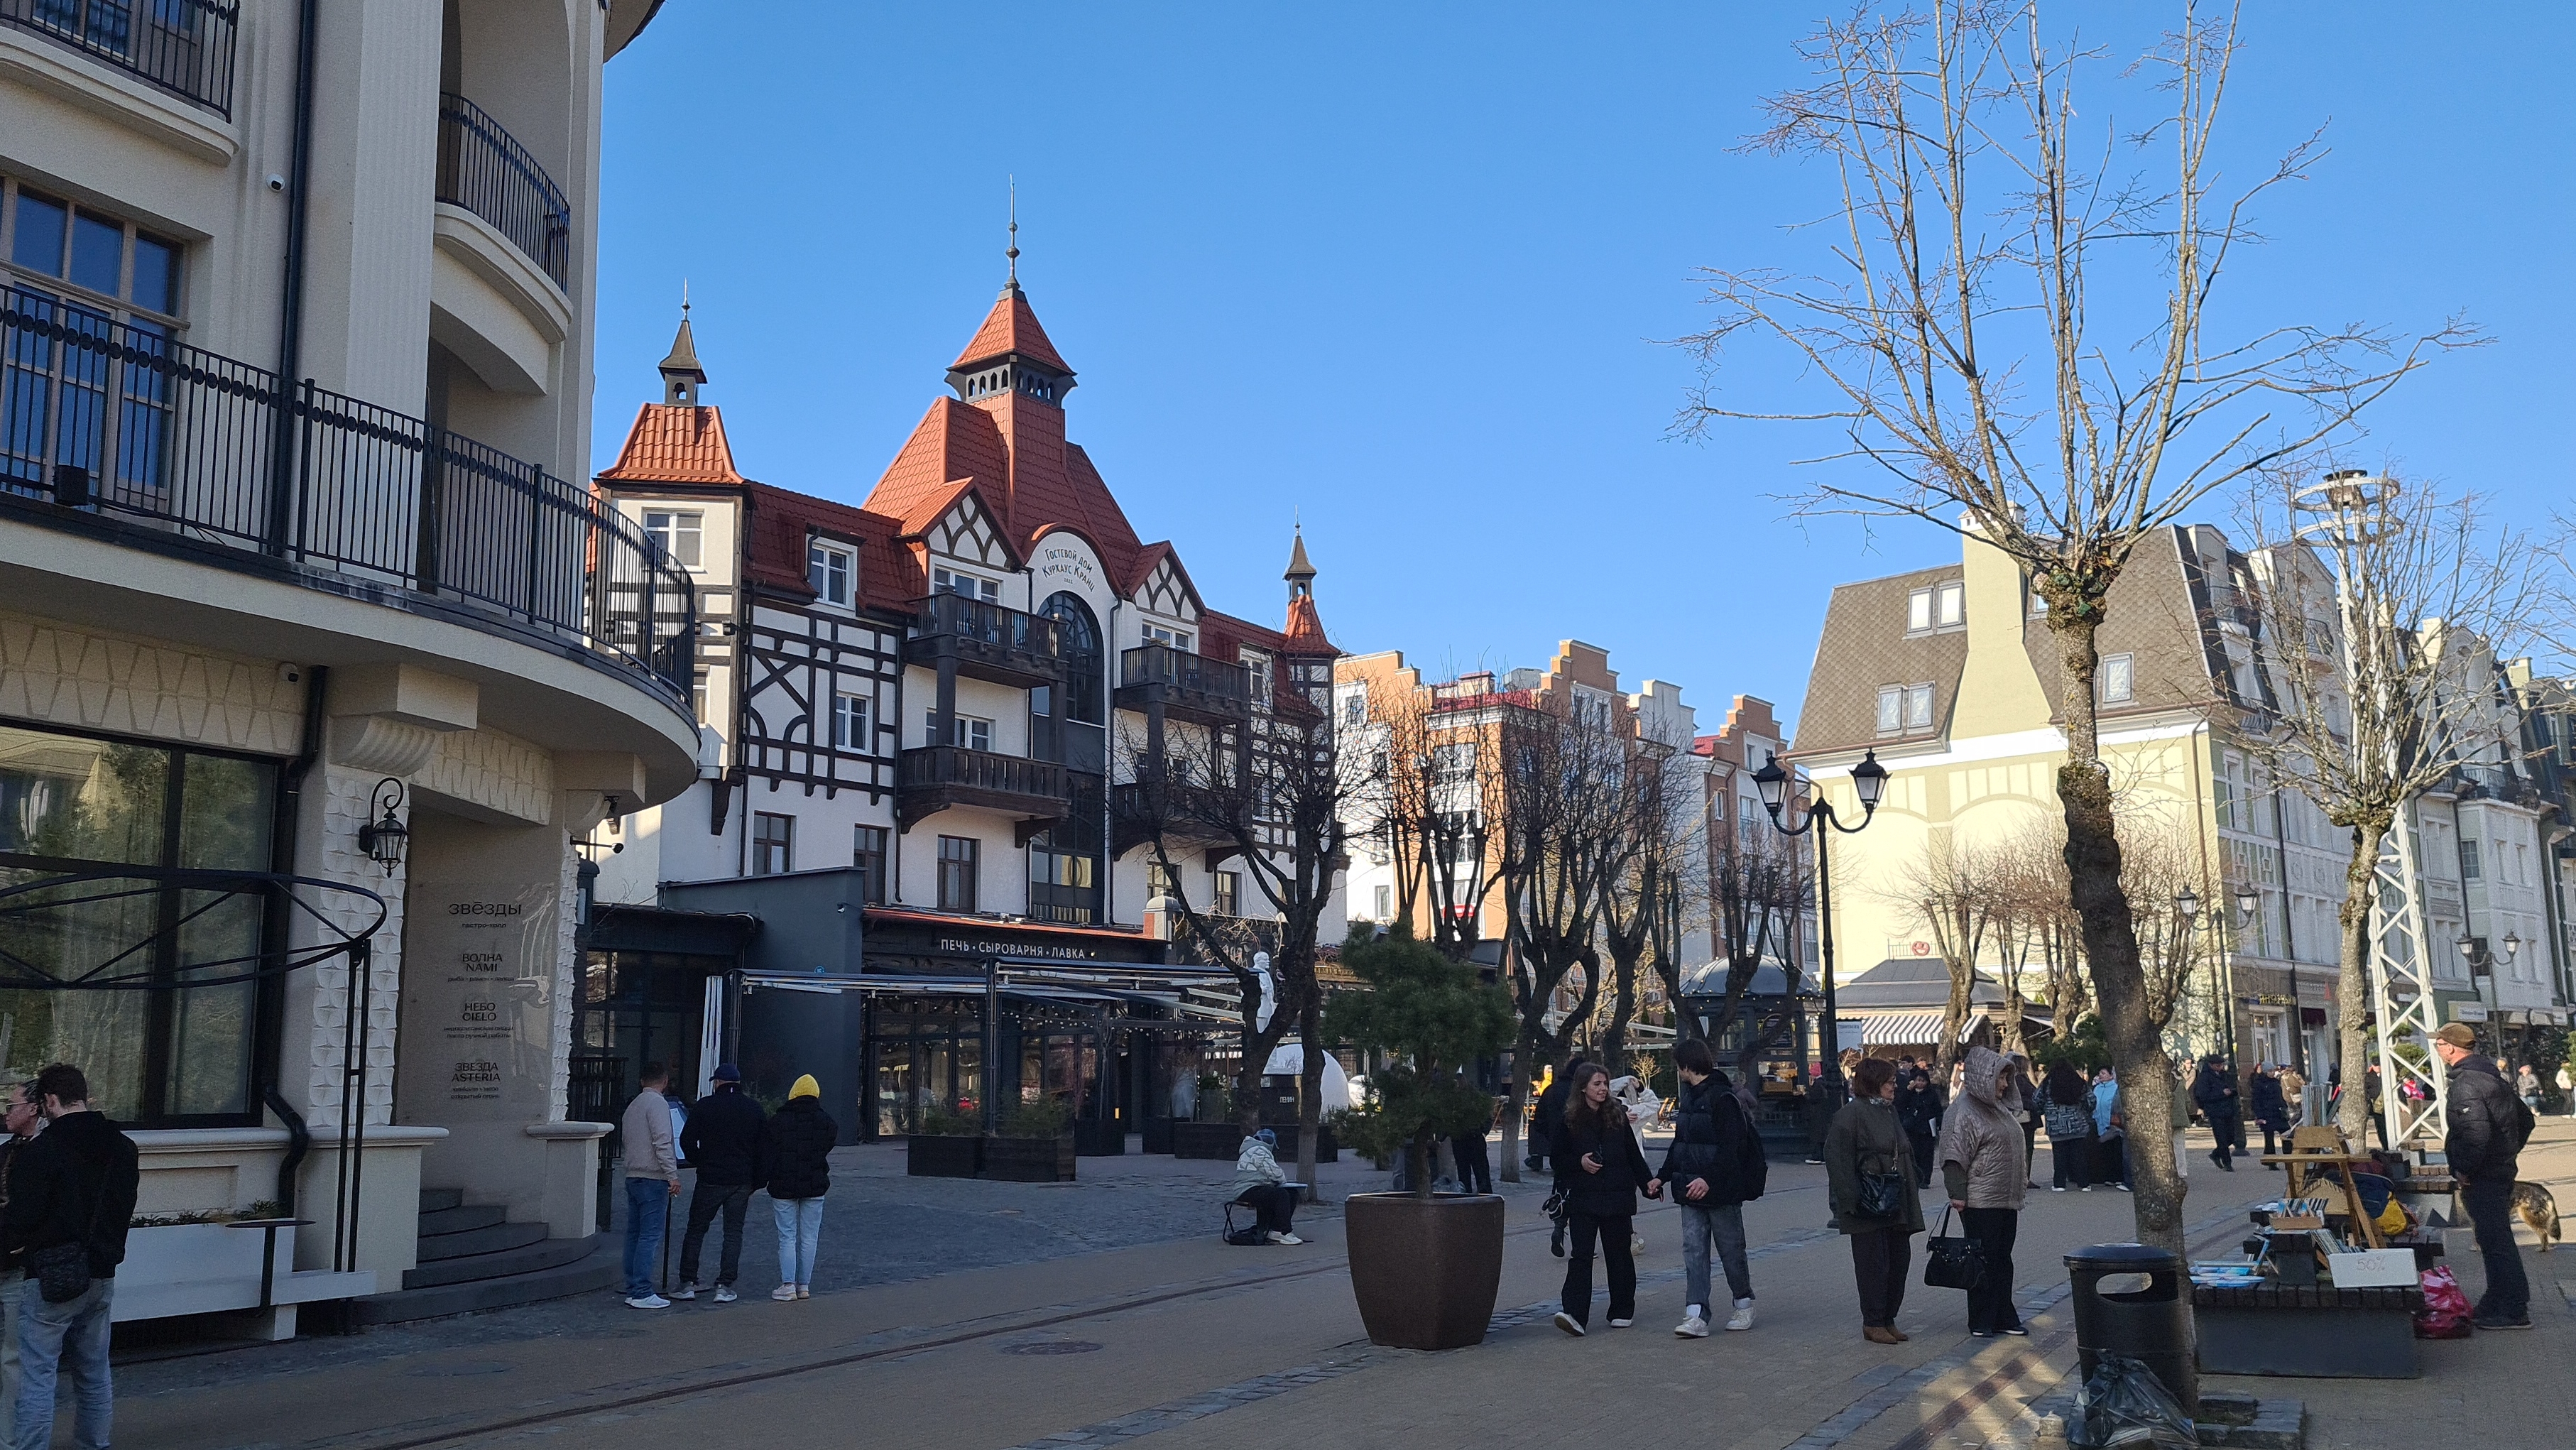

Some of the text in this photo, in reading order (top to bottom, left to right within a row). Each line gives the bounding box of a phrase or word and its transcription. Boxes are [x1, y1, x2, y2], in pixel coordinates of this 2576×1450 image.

[941, 939, 1085, 959] ПЕЧЬ СЫРОВАРНЯ ЛАВКА
[462, 953, 503, 962] ВОЛНА
[466, 963, 498, 971] NAMI
[464, 1002, 496, 1011] НЕБО
[462, 1012, 496, 1021] CIELO
[455, 1062, 498, 1072] ЗВЕЗДА
[452, 1073, 501, 1082] ASTERIA
[2357, 1255, 2386, 1271] 50%
